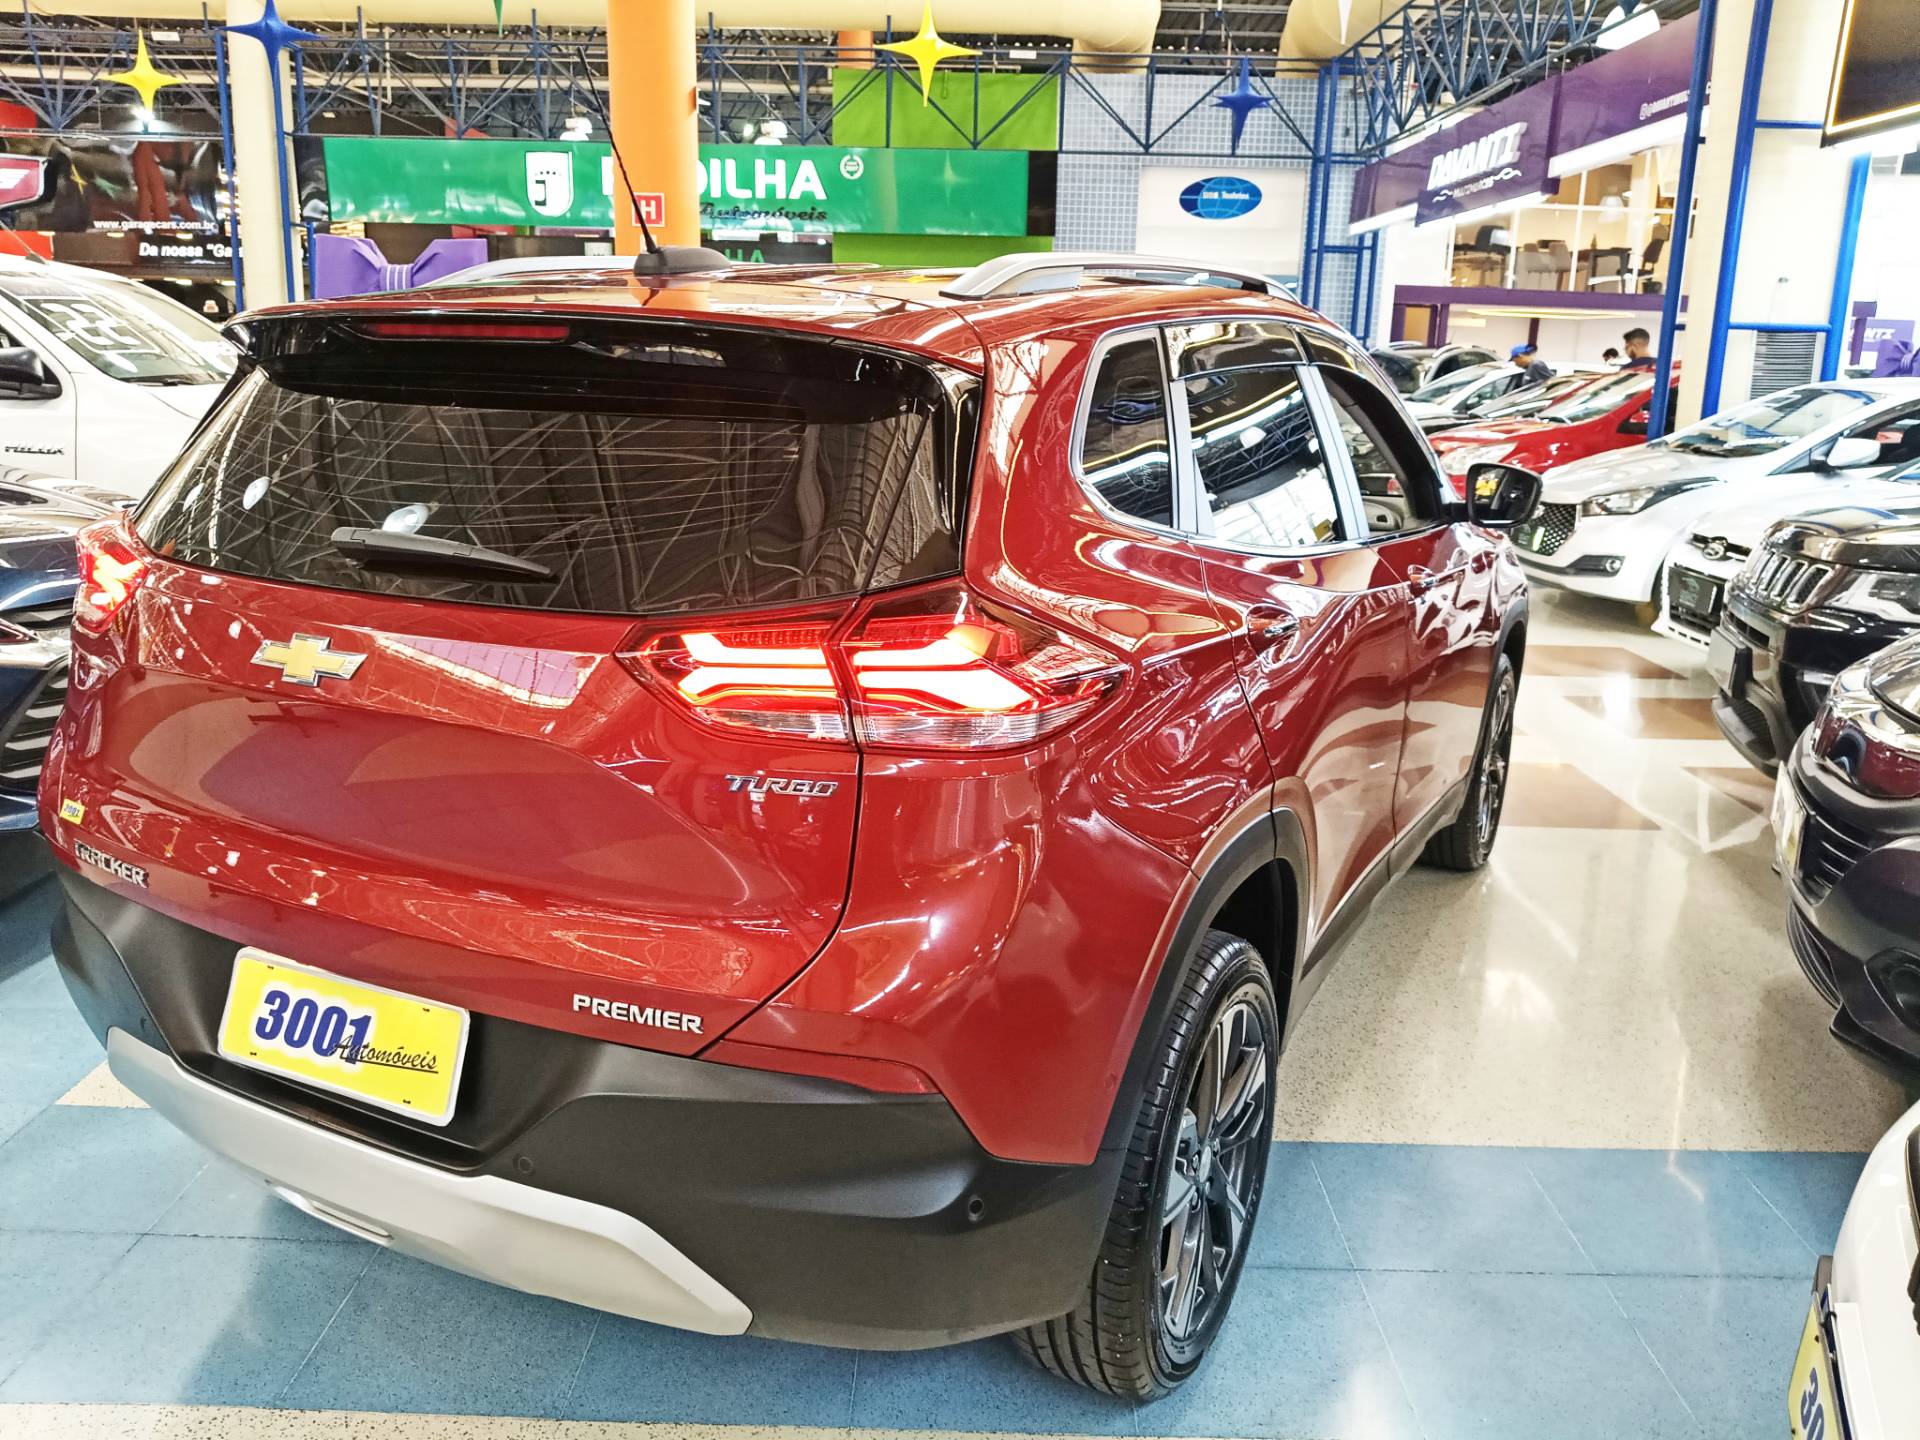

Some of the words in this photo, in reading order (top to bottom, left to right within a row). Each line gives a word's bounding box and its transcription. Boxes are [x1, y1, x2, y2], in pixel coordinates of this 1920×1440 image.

[1427, 121, 1528, 191] DAVANTI
[640, 200, 656, 220] H
[93, 220, 216, 233] www.garagecars.com.br
[138, 242, 158, 257] Da
[161, 246, 204, 258] nossa
[725, 774, 839, 797] TURBO
[255, 989, 372, 1065] 3001
[572, 993, 704, 1034] PREMIER
[332, 1035, 438, 1070] Automóveis
